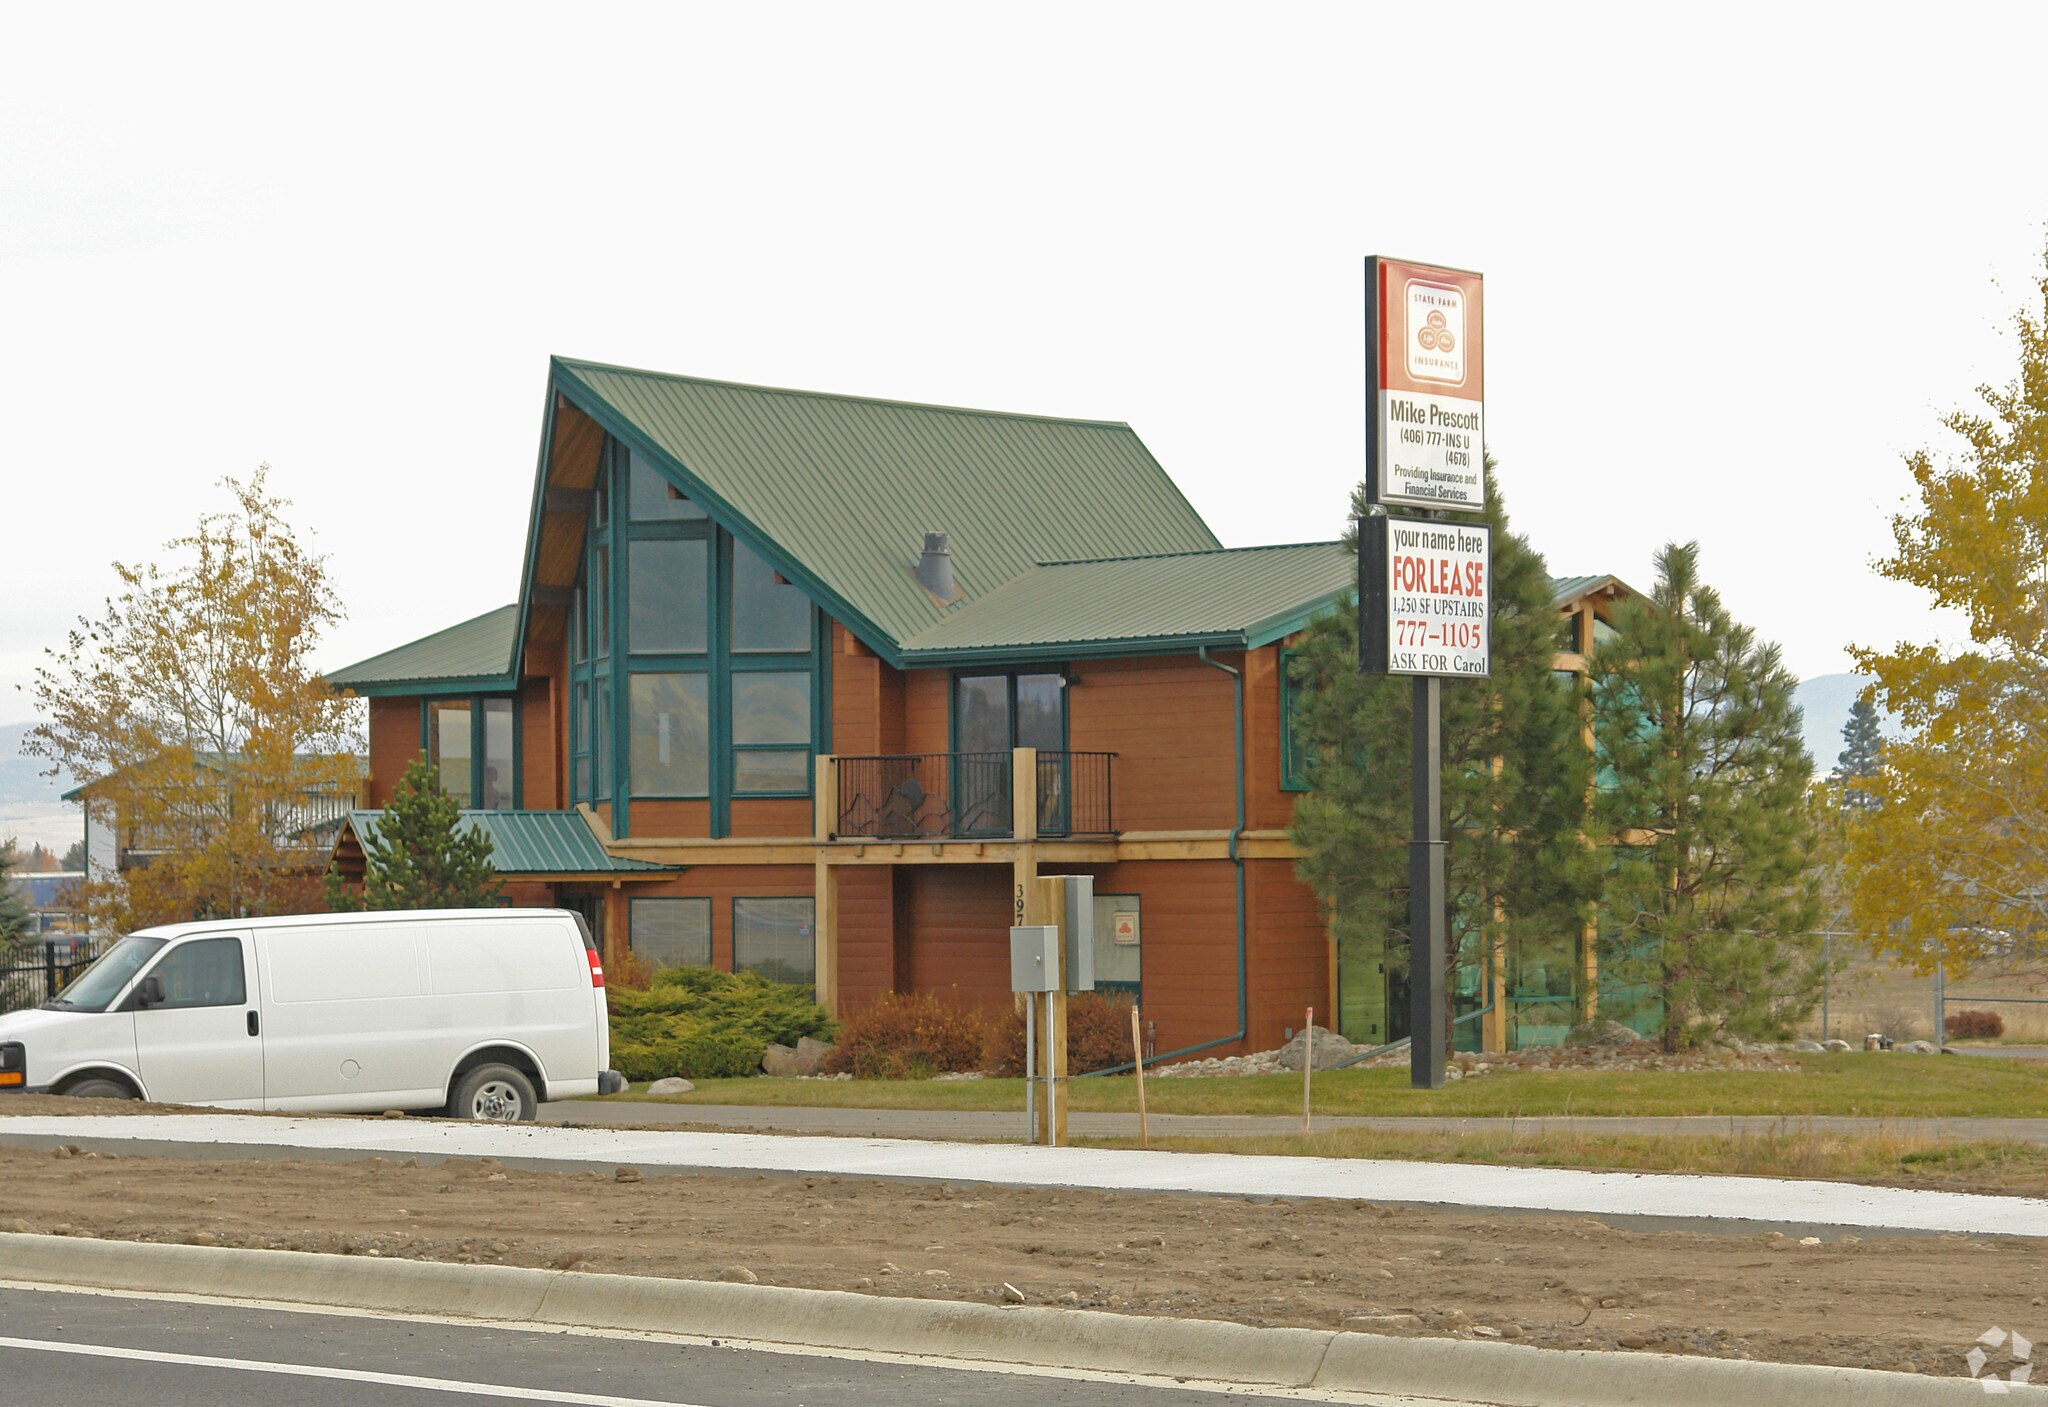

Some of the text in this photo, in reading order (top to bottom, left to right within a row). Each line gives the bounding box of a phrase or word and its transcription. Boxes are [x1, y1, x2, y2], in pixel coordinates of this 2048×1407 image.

[1414, 294, 1457, 307] STATE FARM
[1414, 356, 1459, 370] INSURANCE
[1391, 399, 1480, 431] Mike Prescott
[1400, 428, 1424, 445] (406)
[1445, 449, 1470, 468] (4678)
[1394, 464, 1477, 485] Providing Insurance and
[1404, 481, 1468, 501] Financial Services
[1394, 528, 1483, 554] your name here
[1393, 555, 1483, 597] FOR LEASE
[1393, 596, 1484, 618] 1,250 SF UPSTAIRS
[1396, 620, 1481, 649] 777-1105
[1391, 653, 1485, 674] ASK FOR Carol
